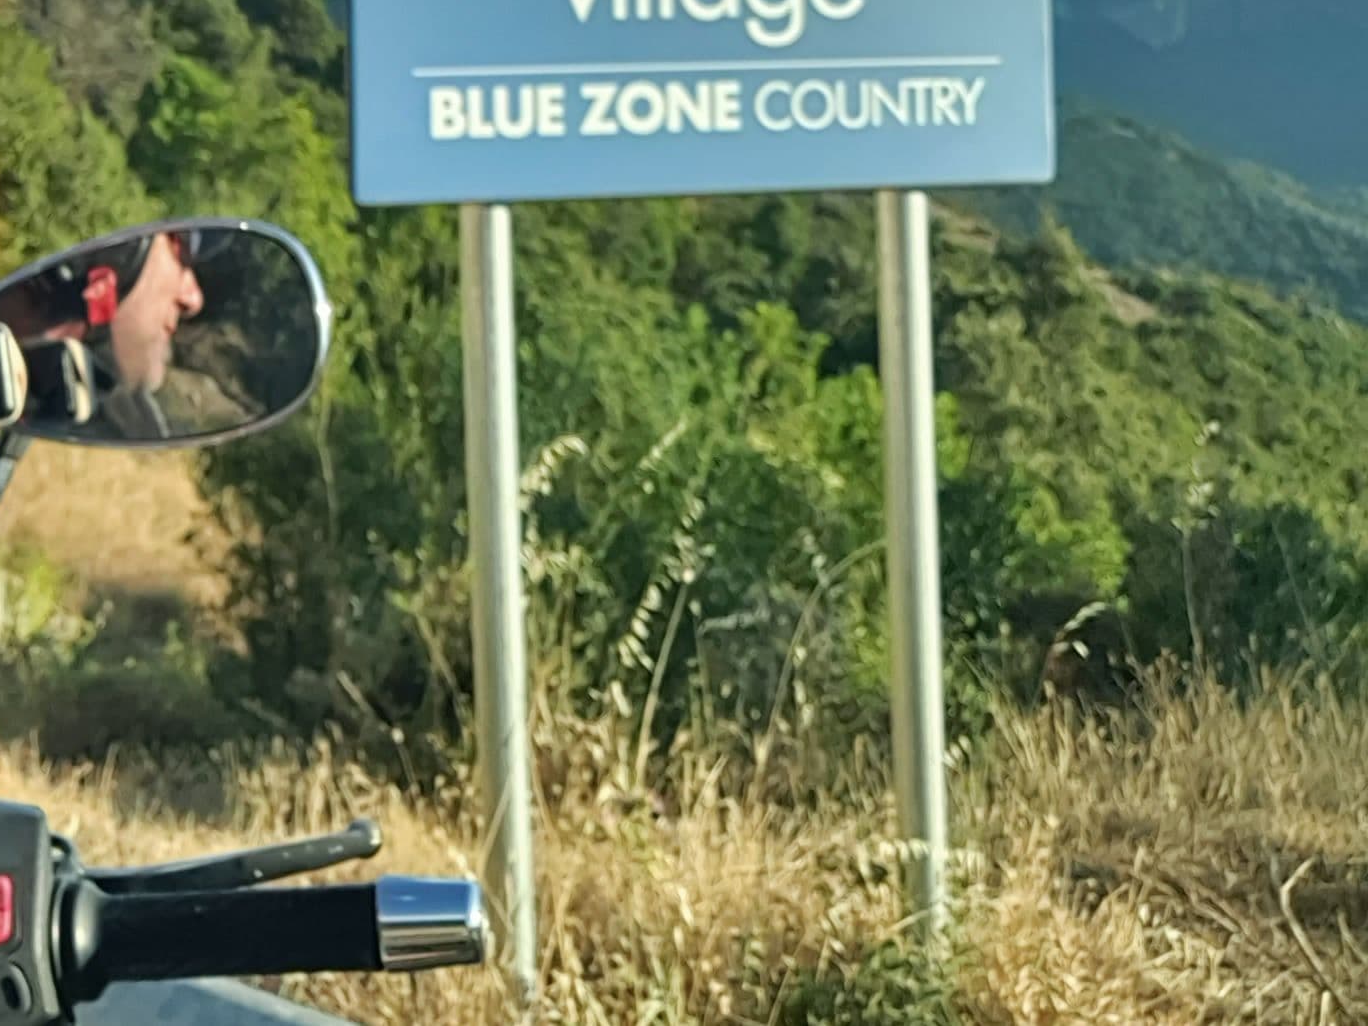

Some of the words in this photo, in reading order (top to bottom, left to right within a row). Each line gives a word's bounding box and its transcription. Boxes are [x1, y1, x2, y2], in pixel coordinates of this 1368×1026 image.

[428, 84, 567, 140] BLUE
[579, 79, 743, 136] ZONE
[753, 76, 986, 131] COUNTRY
